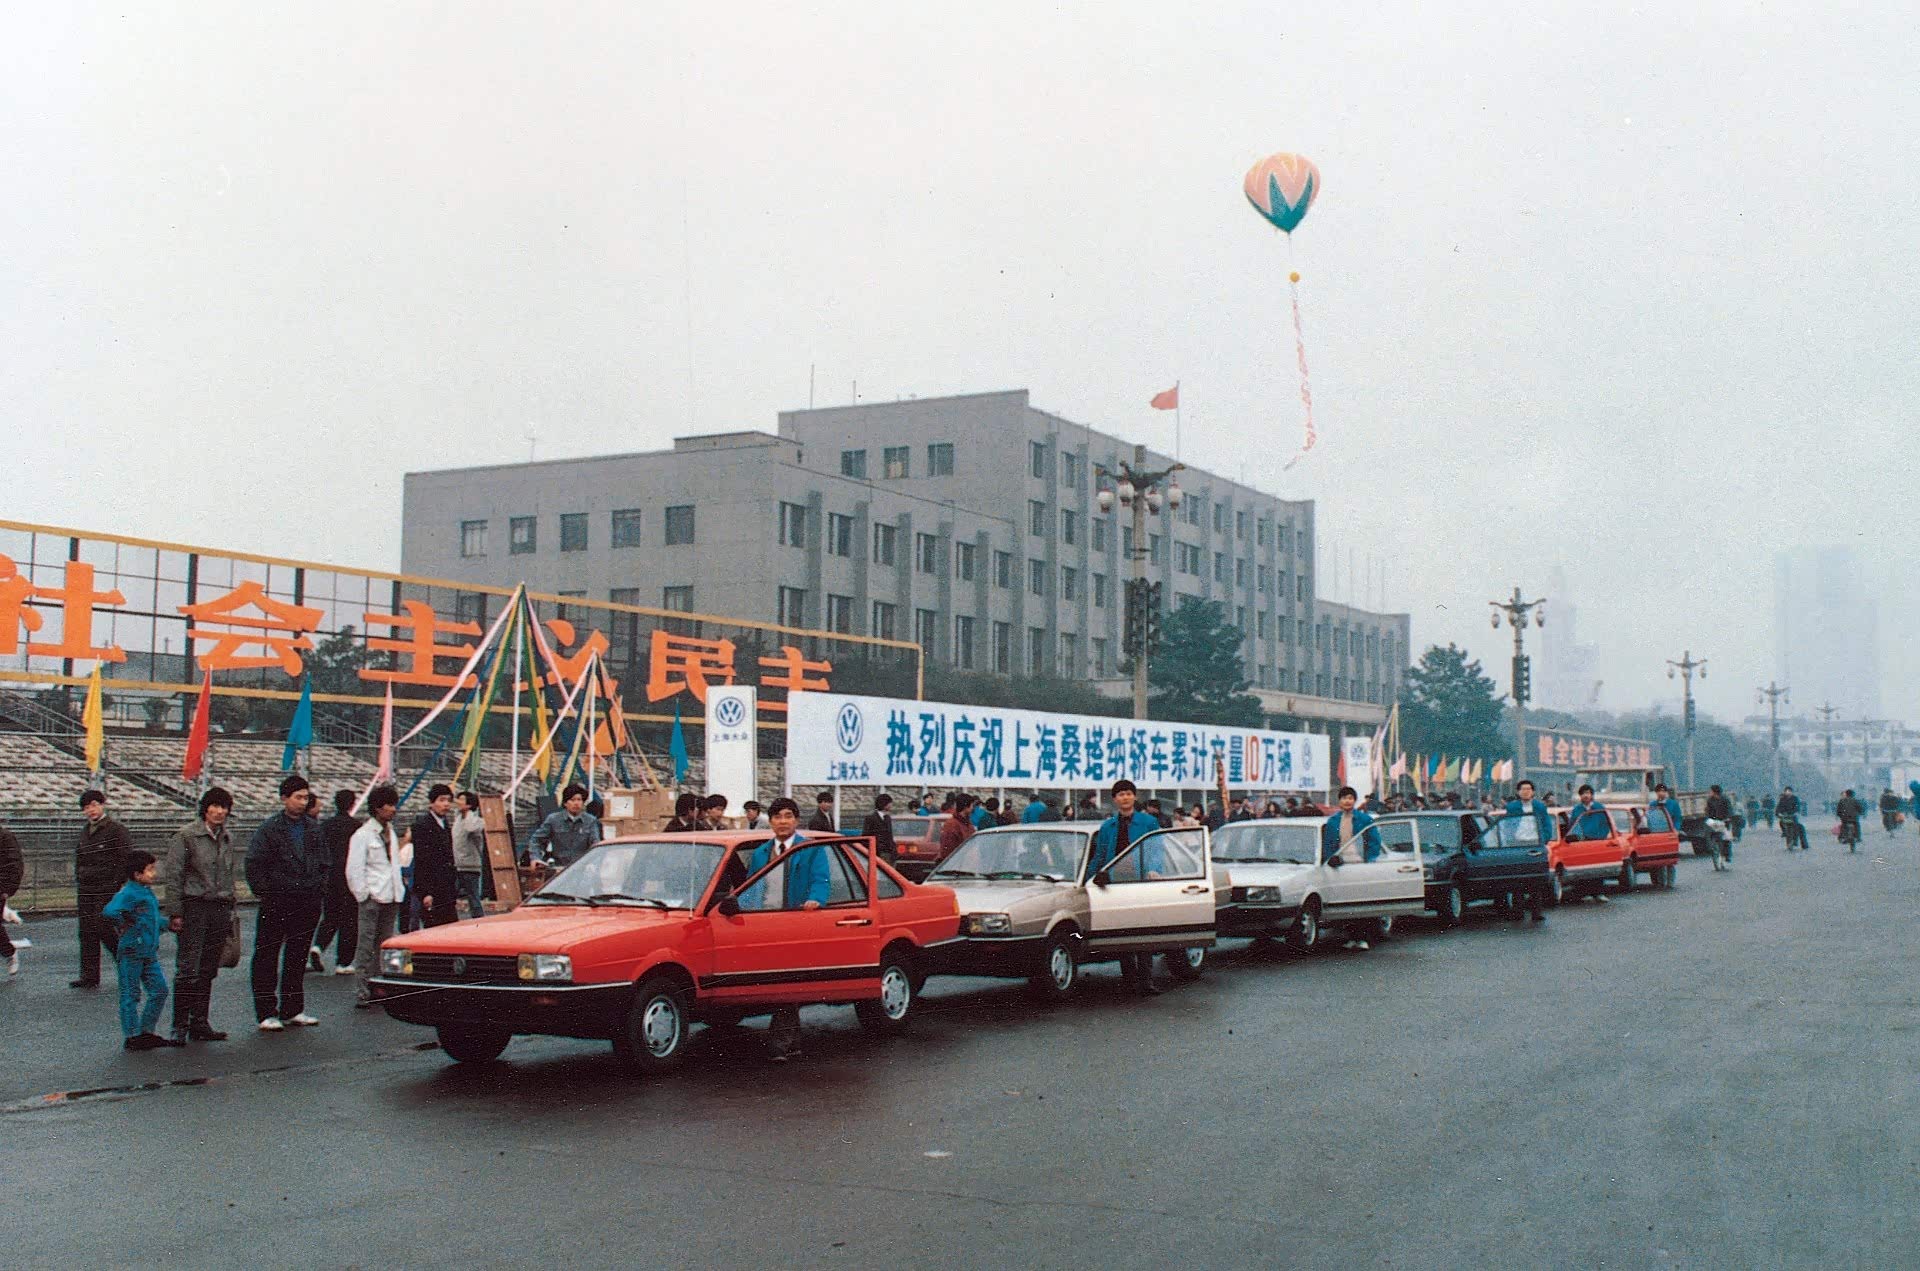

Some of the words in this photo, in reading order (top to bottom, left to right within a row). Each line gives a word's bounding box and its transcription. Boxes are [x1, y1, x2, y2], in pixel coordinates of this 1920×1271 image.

[826, 760, 870, 781] 上海大众
[886, 709, 1293, 784] 热烈庆祝上海桑塔纳轿车累计产量10万辆
